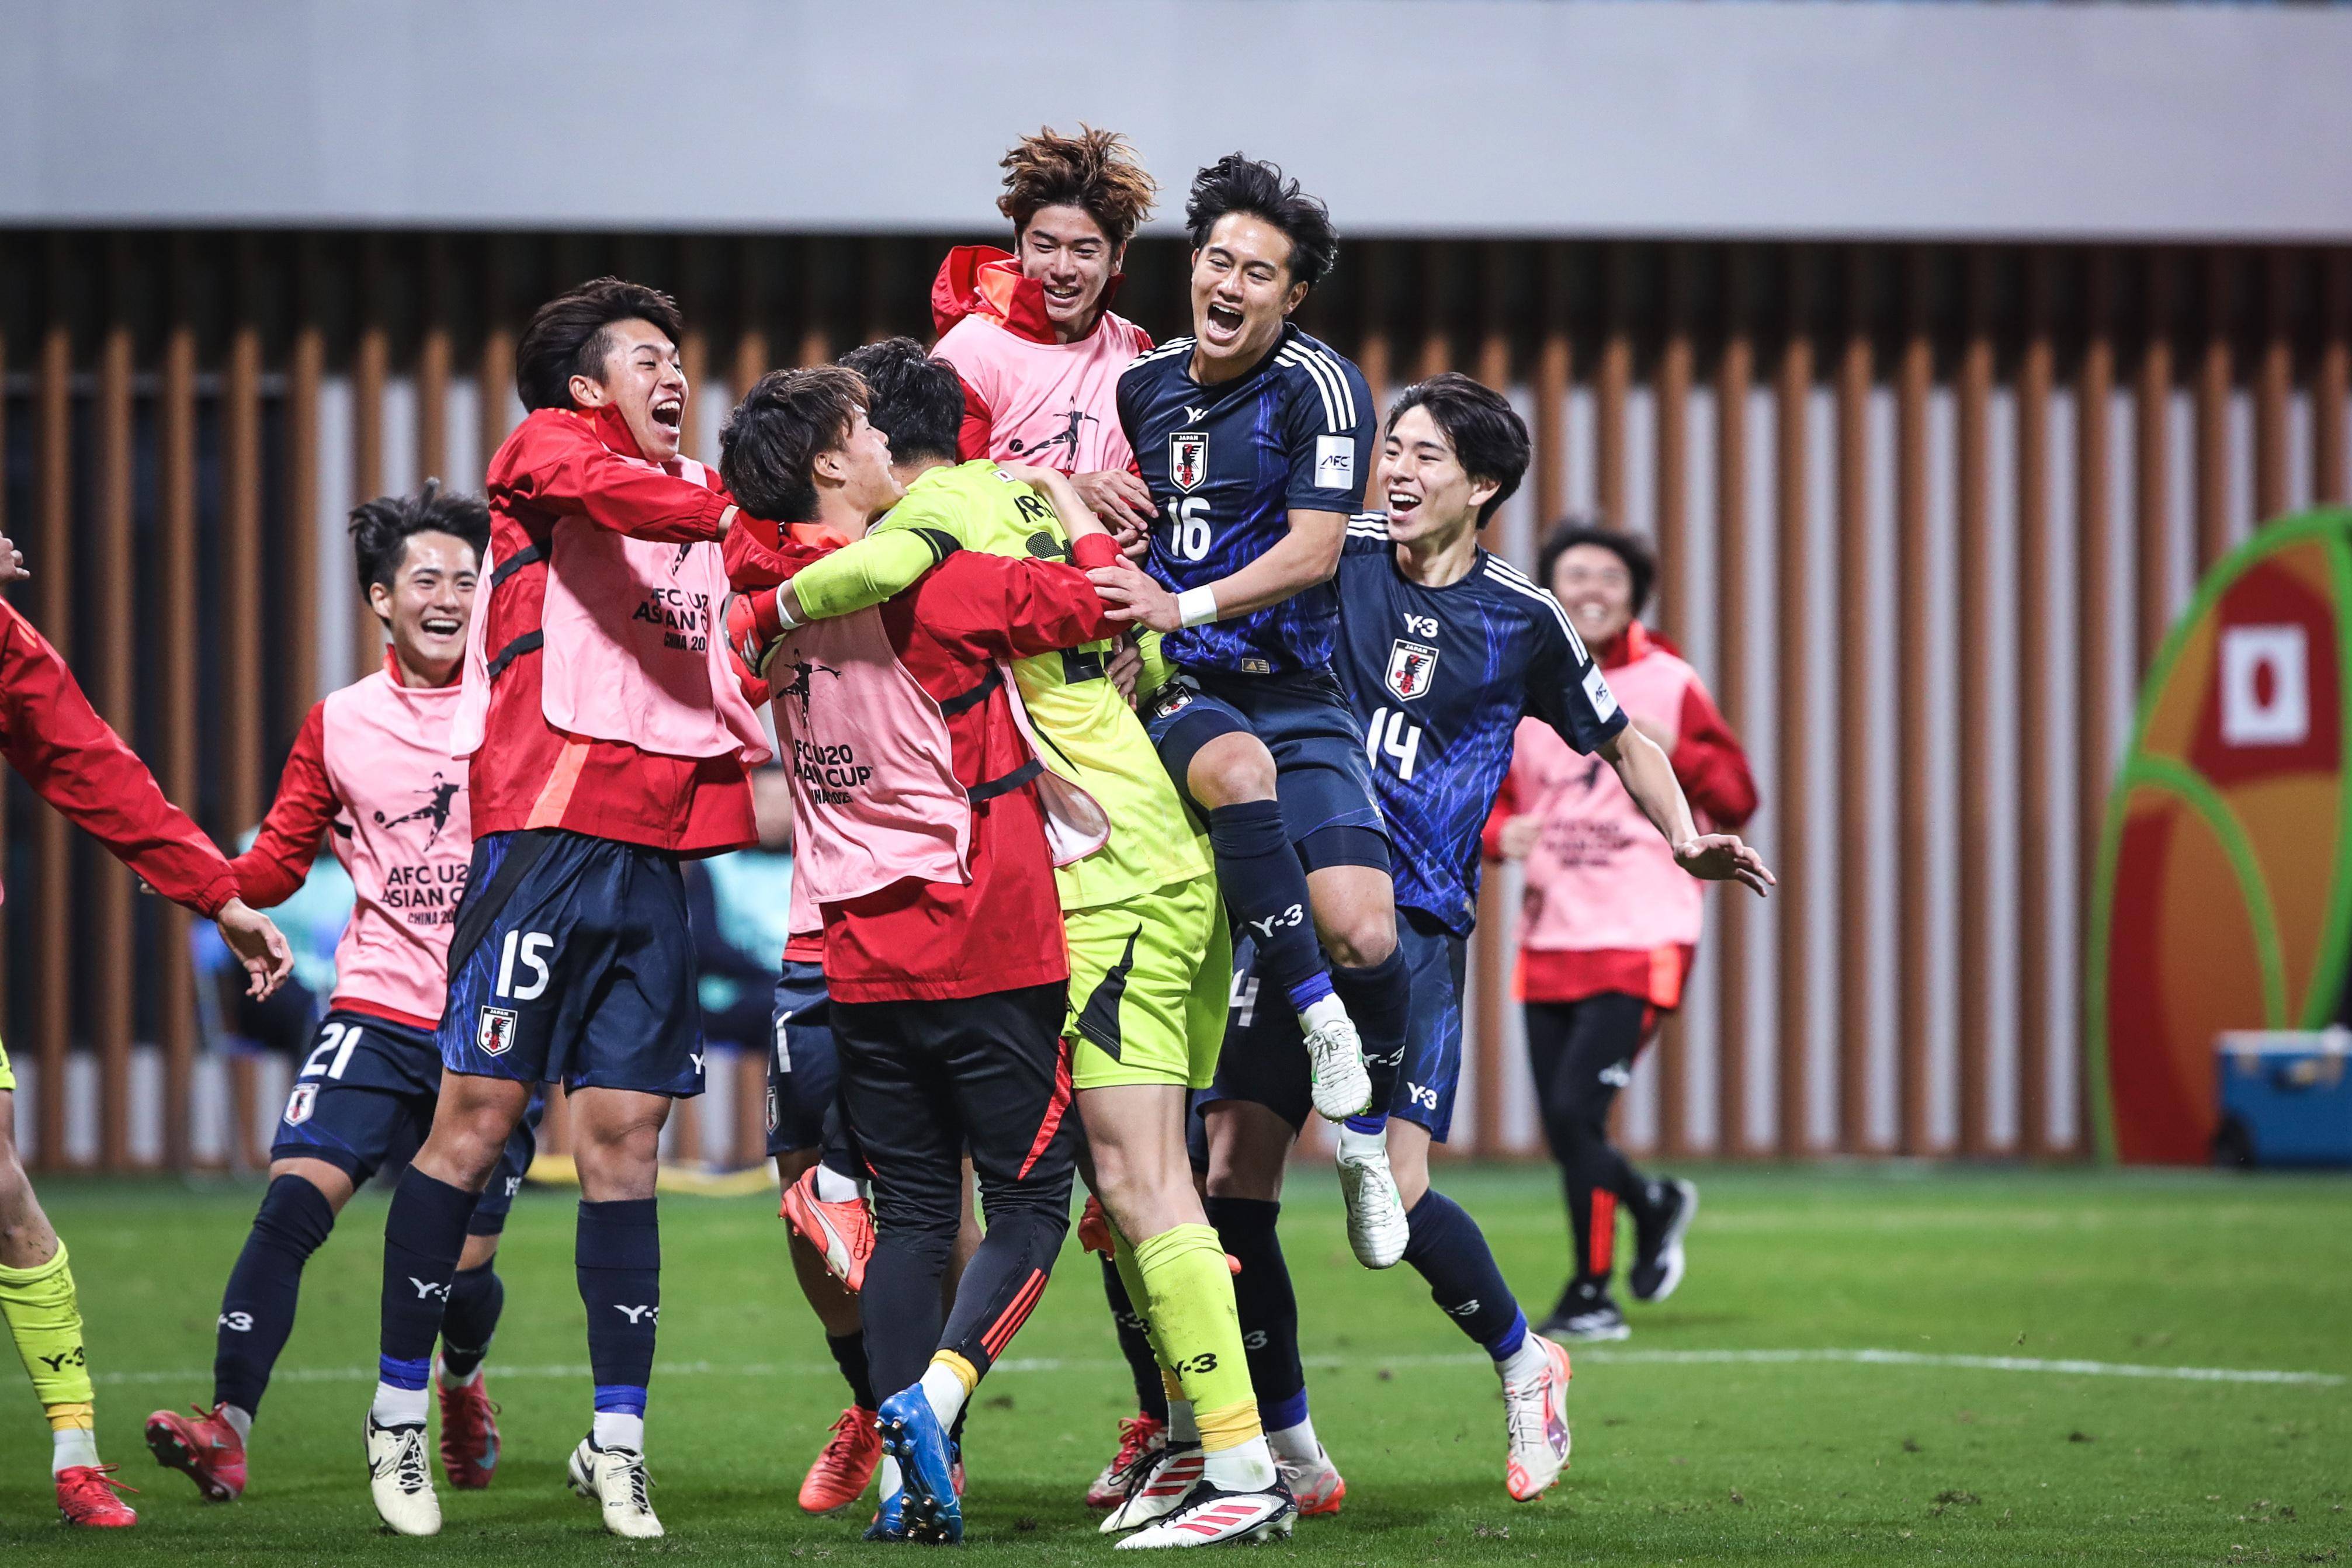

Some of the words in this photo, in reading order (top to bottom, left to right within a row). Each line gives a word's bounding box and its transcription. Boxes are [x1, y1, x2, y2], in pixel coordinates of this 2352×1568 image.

[1320, 455, 1351, 467] AFC
[1180, 473, 1195, 482] JFA
[1167, 495, 1212, 561] 16
[651, 588, 683, 606] FC
[686, 592, 709, 613] U2
[632, 601, 696, 631] ASAN
[1403, 612, 1439, 639] Y-3
[691, 636, 706, 651] 20
[1404, 643, 1428, 654] JAPAN
[1396, 681, 1415, 692] JFA
[794, 739, 813, 763] FC
[811, 744, 854, 766] U20
[1365, 706, 1422, 781] 14
[387, 866, 432, 886] AFC
[438, 862, 469, 884] U2
[380, 887, 444, 908] ASIAN
[408, 910, 439, 926] CHINA
[440, 908, 455, 924] 20
[1249, 903, 1304, 938] Y-3
[495, 929, 554, 1000] 15
[1229, 968, 1260, 1027] 4
[300, 1022, 363, 1080] 21
[1407, 1081, 1438, 1110] Y-3
[217, 1310, 254, 1333] -3
[1170, 1352, 1217, 1382] Y-3
